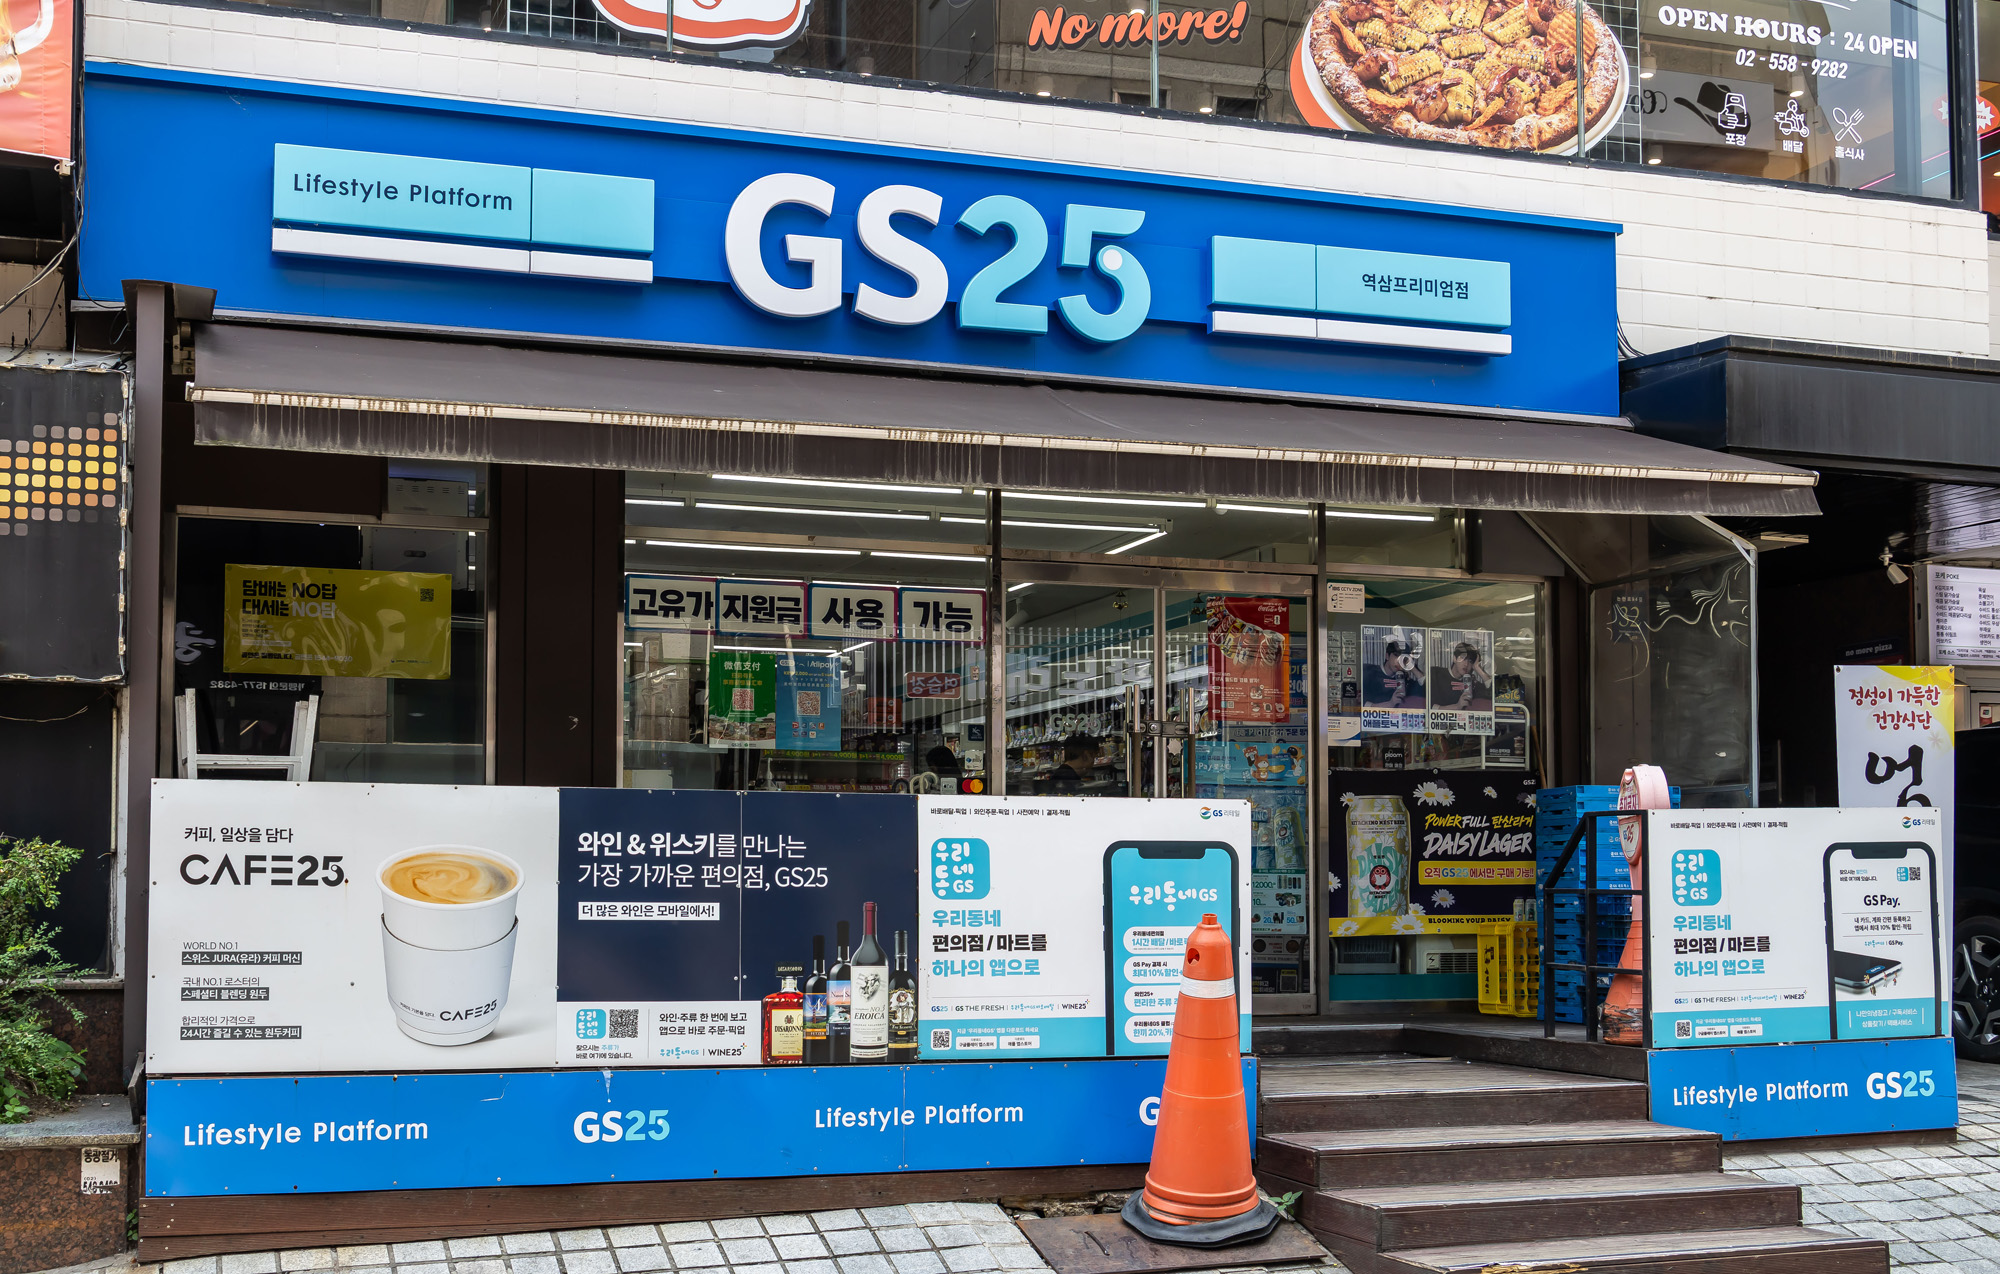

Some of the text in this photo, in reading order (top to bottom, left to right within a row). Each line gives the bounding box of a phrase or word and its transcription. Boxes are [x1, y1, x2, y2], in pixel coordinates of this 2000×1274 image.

[1029, 1, 1249, 49] No more!
[1658, 5, 1729, 35] OPEN
[1734, 14, 1822, 47] HOURS
[1843, 31, 1865, 53] 24
[1869, 33, 1918, 60] OPEN
[1735, 48, 1755, 67] 02
[1769, 53, 1798, 73] 558
[1811, 59, 1849, 79] 9282
[1725, 132, 1747, 147] 포장
[1782, 139, 1804, 154] 배달
[293, 173, 514, 211] Lifestyle Platform
[725, 172, 1151, 344] GS25
[1362, 273, 1469, 300] 역삼프리미엄점
[242, 579, 338, 600] 담배는 NO답
[242, 599, 290, 616] 대세는
[631, 587, 973, 633] 고유가 지원금 사용 가능
[724, 661, 761, 671] 微信支付
[1848, 685, 1941, 706] 정성이 가득한
[1872, 710, 1932, 730] 건강식단
[1212, 809, 1240, 818] GS 리테일
[1425, 813, 1534, 830] POWERFULL 탄산라거
[184, 826, 294, 843] 커피, 일상을 담다
[577, 832, 807, 859] 와인 & 위스키를 만나는
[936, 841, 971, 863] 우리
[1422, 830, 1533, 859] DAISY LAGER
[179, 853, 346, 888] CAFE25
[1675, 854, 1704, 872] 우리
[577, 862, 829, 891] 가장 가까운 편의점, GS25
[1424, 867, 1441, 879] 오직
[1496, 867, 1515, 878] 구매
[1129, 880, 1218, 912] 우리동네GS
[1863, 894, 1901, 909] GS Pay.
[582, 904, 716, 918] 더 많은 와인은 모바일에서!
[932, 909, 1002, 928] 우리동네
[1673, 915, 1732, 932] 우리동네
[183, 941, 238, 951] WORLD NO.1
[932, 934, 984, 952] 편의점
[996, 933, 1048, 952] 마트를
[183, 952, 301, 965] 스위스 JURA(유라) 커피 머신
[932, 959, 1041, 978] 하나의 앱으로
[1674, 959, 1765, 977] 하나의 앱으로
[182, 976, 260, 987] 국내 NO.1 로스터의
[182, 989, 268, 1000] 스페셜티 블렌딩 원두
[1134, 998, 1156, 1008] 편리한
[1157, 998, 1172, 1008] 주류
[439, 998, 497, 1021] CAFE25
[700, 1012, 709, 1022] 한
[710, 1012, 729, 1022] 번에
[730, 1012, 747, 1022] 보고
[854, 1012, 885, 1020] EROICA
[182, 1015, 256, 1026] 합리적인 가격으로
[181, 1027, 300, 1039] 24시간 즐길 수 있는 원두커피
[659, 1025, 686, 1036] 앱으로
[688, 1025, 706, 1036] 바로
[708, 1048, 743, 1057] WINE25
[1673, 1070, 1936, 1110] Lifestyle Platform GS25
[573, 1109, 670, 1143] GS25
[814, 1101, 1024, 1135] Lifestyle Platform
[184, 1119, 428, 1151] Lifestyle Platform
